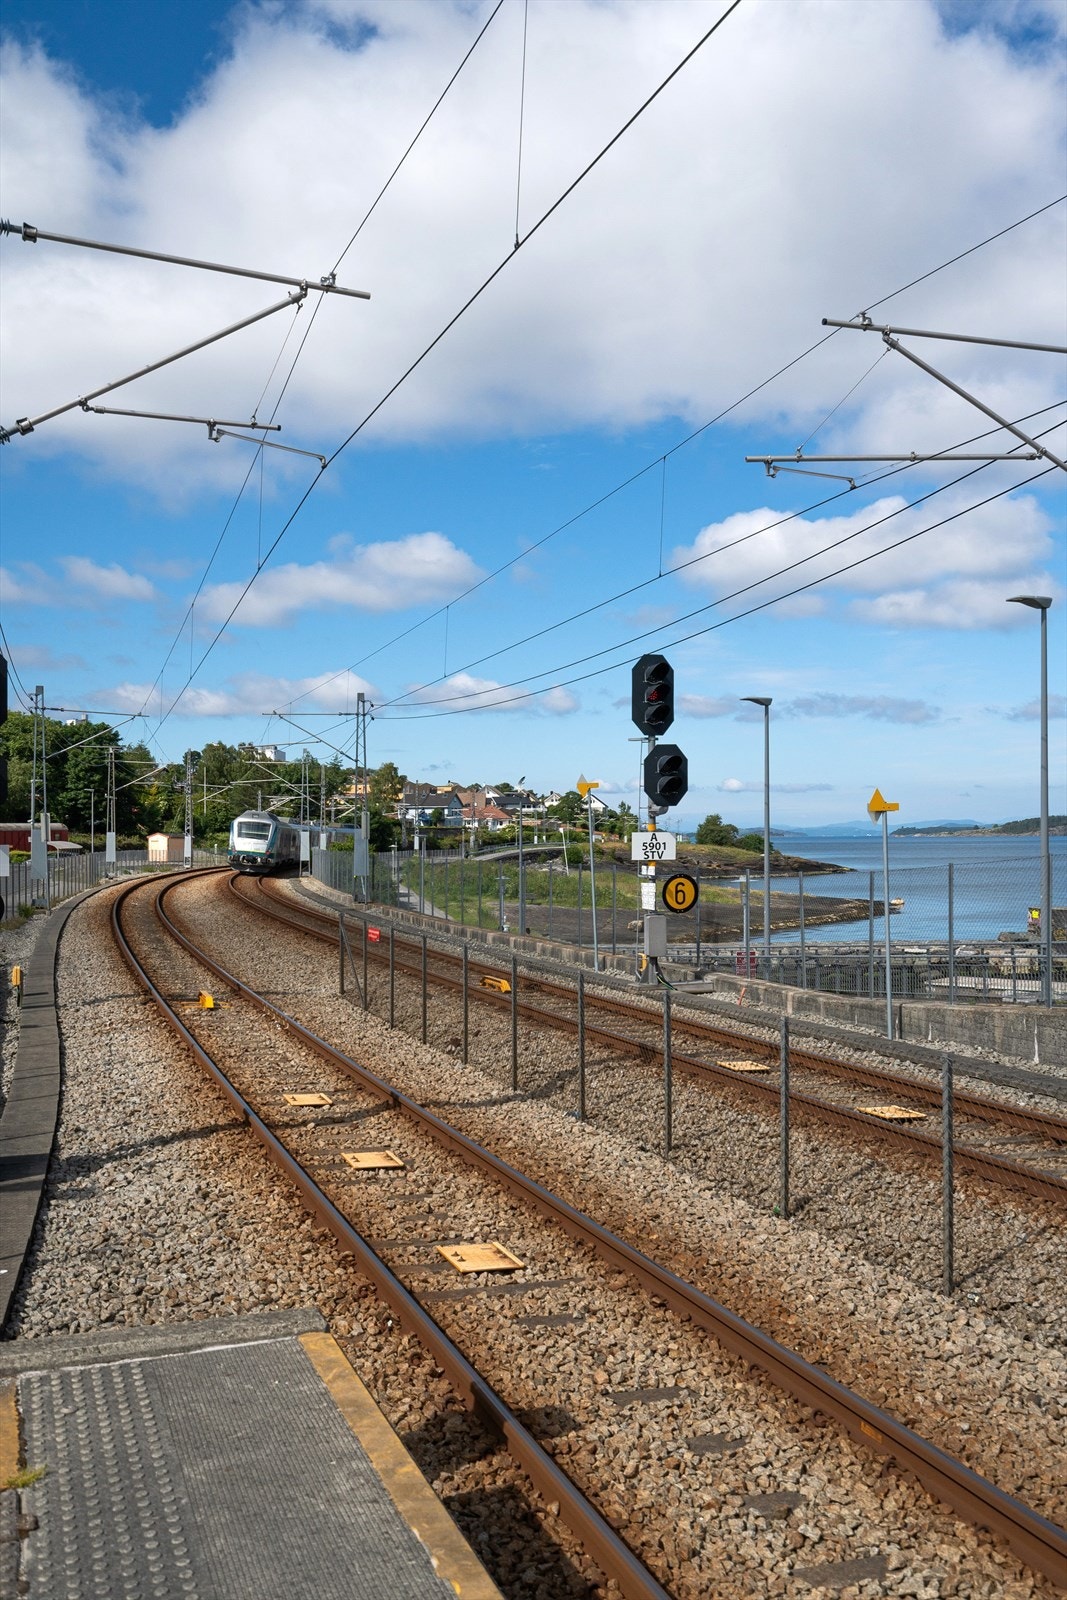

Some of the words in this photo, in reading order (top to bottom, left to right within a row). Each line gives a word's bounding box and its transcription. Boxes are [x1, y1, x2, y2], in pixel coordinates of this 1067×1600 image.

[650, 833, 658, 841] A
[642, 842, 667, 850] 5901
[643, 851, 664, 859] STV
[675, 882, 685, 905] 6
